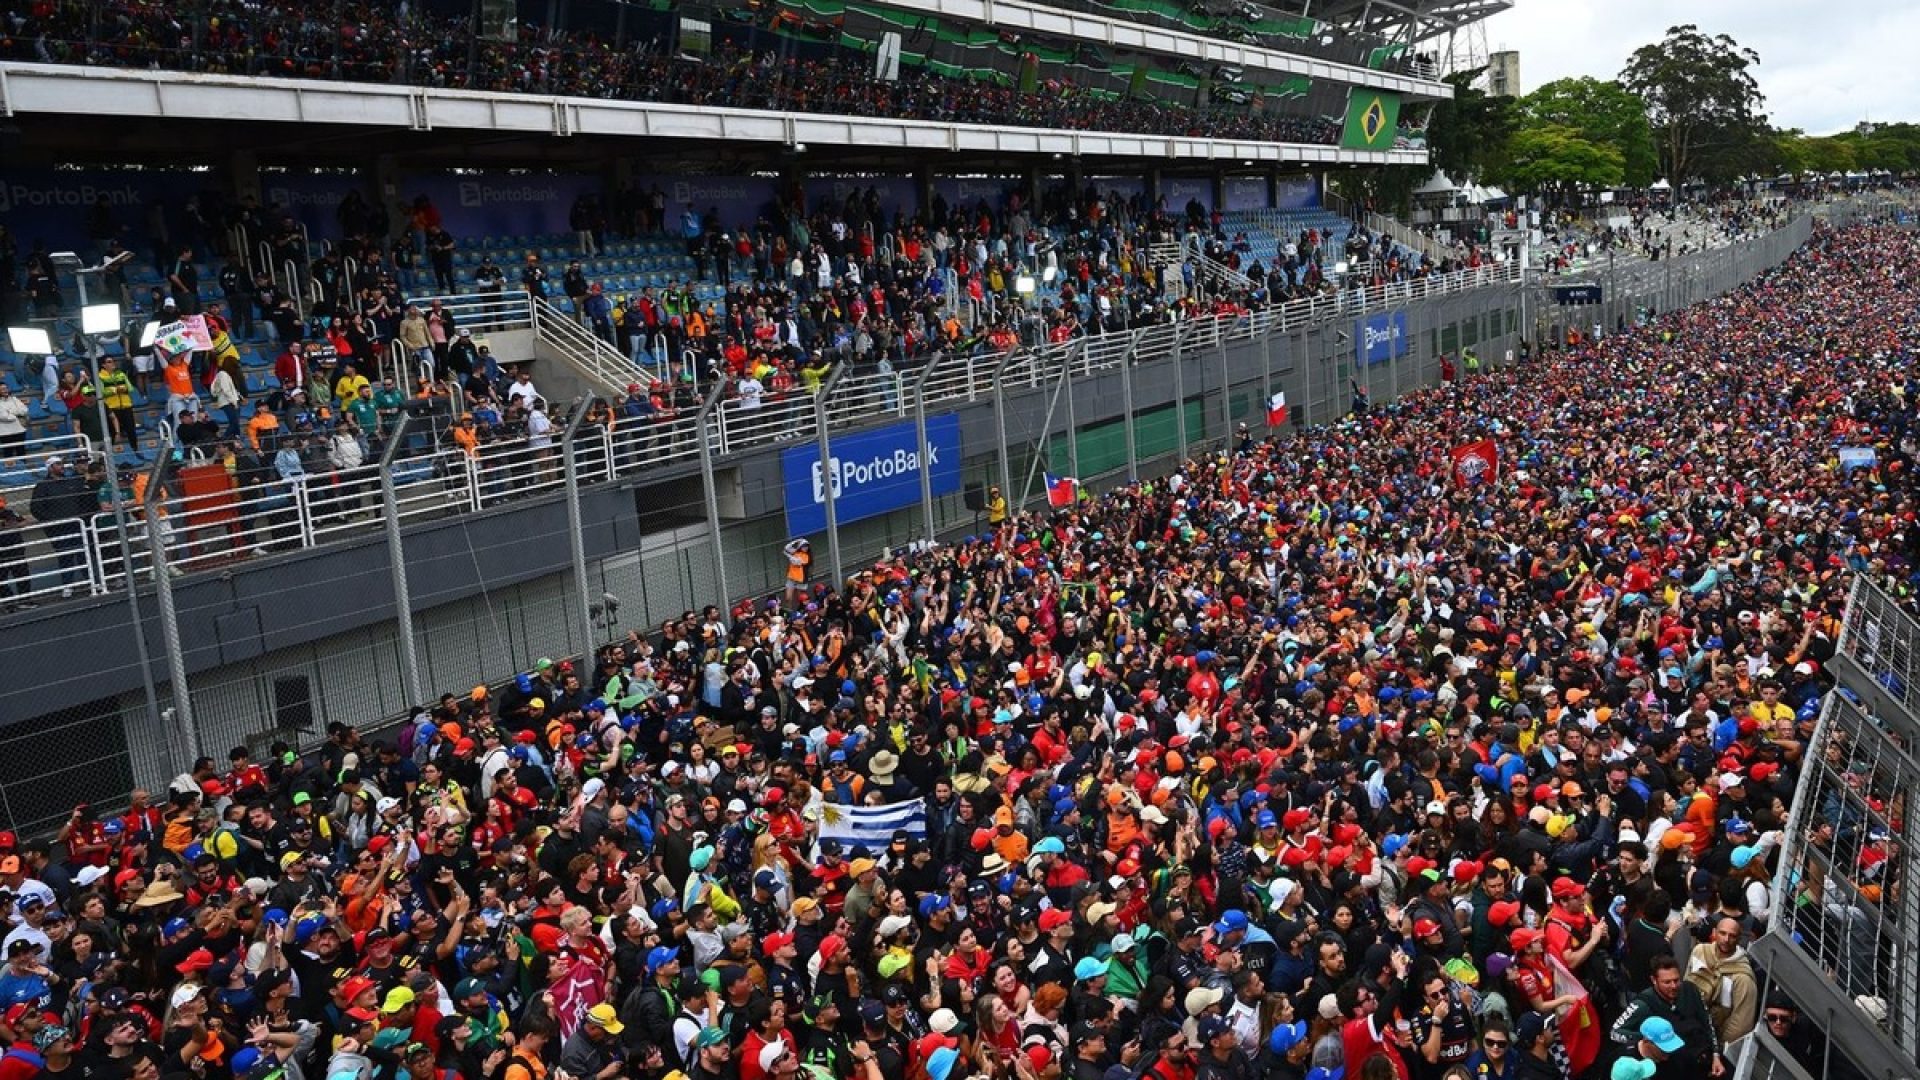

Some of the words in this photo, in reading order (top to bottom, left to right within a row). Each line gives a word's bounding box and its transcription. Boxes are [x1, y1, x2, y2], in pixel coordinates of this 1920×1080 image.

[290, 191, 344, 206] PortoBa
[482, 186, 559, 202] PortoBank
[842, 441, 939, 488] PortoBak
